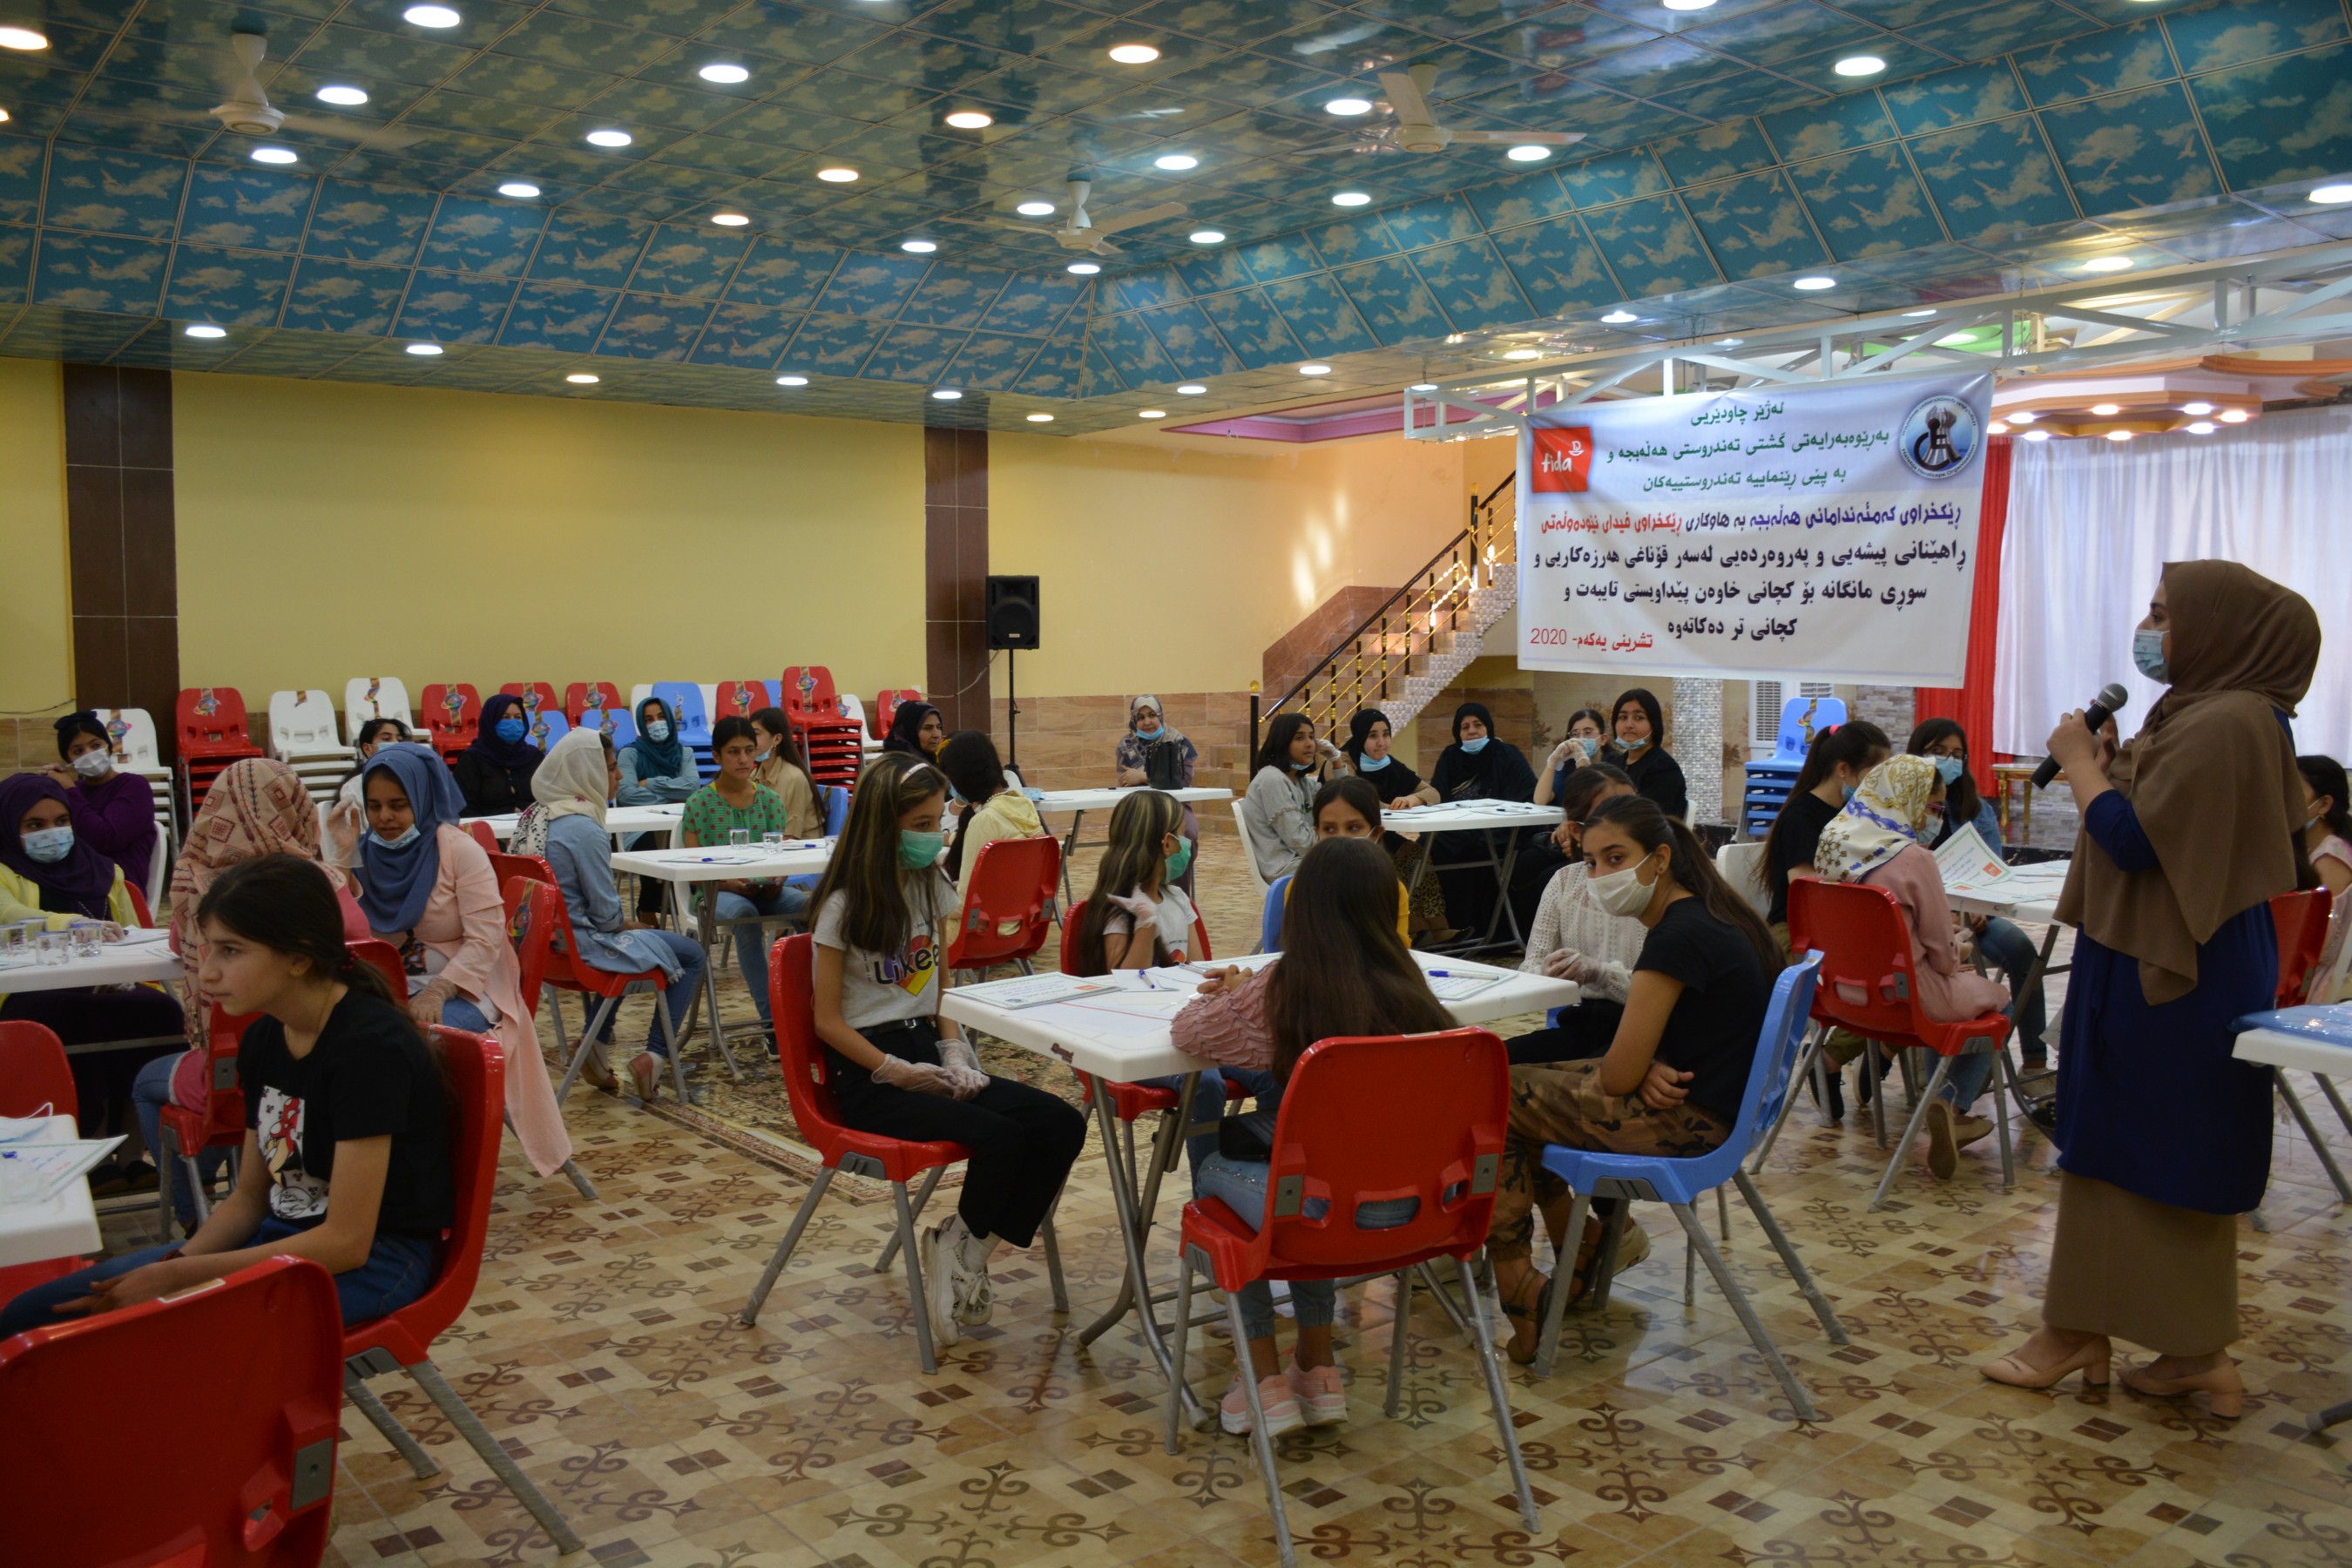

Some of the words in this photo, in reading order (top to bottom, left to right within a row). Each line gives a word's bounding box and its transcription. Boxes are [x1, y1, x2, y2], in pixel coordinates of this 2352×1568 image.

[1690, 404, 1747, 427] چاودێریی
[1753, 400, 1786, 422] لەژێر
[1673, 438, 1741, 461] تەندروستی
[1746, 431, 1786, 456] گشتی
[1541, 450, 1572, 473] fida
[1606, 449, 1614, 463] و
[1801, 468, 1828, 488] پێی
[1833, 467, 1848, 483] بە
[1686, 511, 1730, 532] هاوکاری
[1733, 514, 1746, 531] بە
[1533, 554, 1541, 568] و
[1544, 545, 1621, 568] هەرزەکاریی
[1624, 544, 1669, 569] قۆناغی
[1673, 544, 1713, 569] لەسەر
[1720, 545, 1809, 569] پەروەردەیی
[1815, 551, 1825, 568] و
[1831, 541, 1888, 568] پیشەیی
[1563, 587, 1571, 602] و
[1576, 580, 1619, 601] تایبەت
[1623, 580, 1689, 605] پێداویستی
[1694, 581, 1741, 605] خاوەن
[1747, 580, 1795, 606] کچانی
[1800, 580, 1815, 605] بۆ
[1821, 579, 1874, 600] مانگانە
[1530, 627, 1568, 645] 2020
[1667, 616, 1725, 639] دەکاتەوە
[1729, 618, 1745, 641] تر
[1750, 617, 1799, 643] کچانی
[1612, 631, 1654, 653] تشرینی
